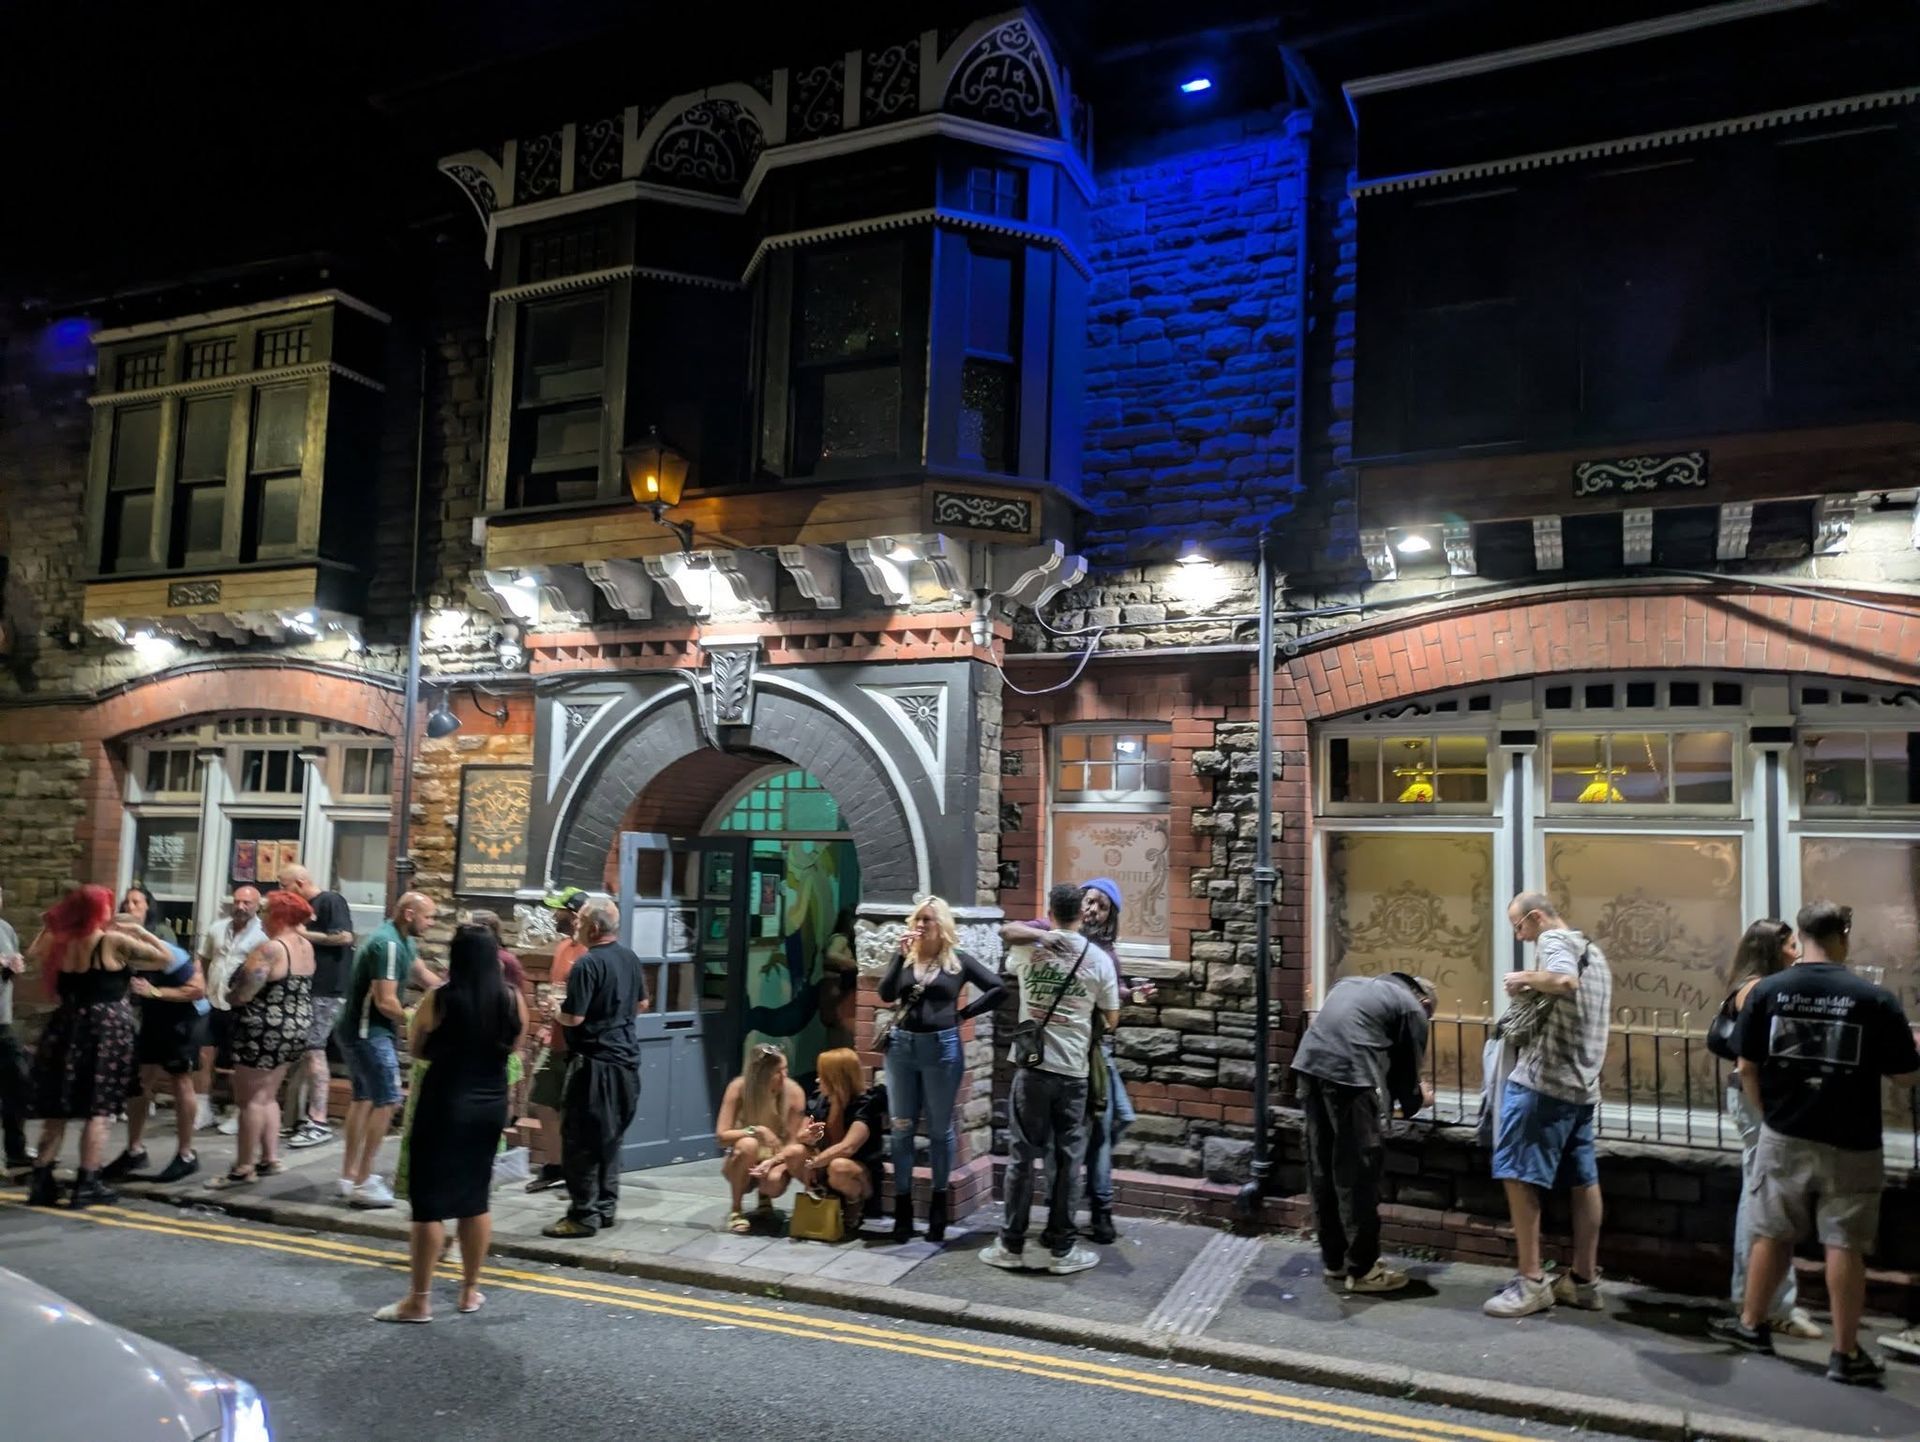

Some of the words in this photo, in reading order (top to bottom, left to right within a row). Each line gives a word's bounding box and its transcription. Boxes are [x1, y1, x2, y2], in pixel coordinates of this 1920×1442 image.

[1612, 971, 1711, 1010] MCARN
[1777, 992, 1789, 1003] In
[1791, 993, 1812, 1004] the
[1814, 995, 1856, 1008] middle
[1611, 1005, 1678, 1027] OTEL
[1797, 1004, 1848, 1016] nowhere
